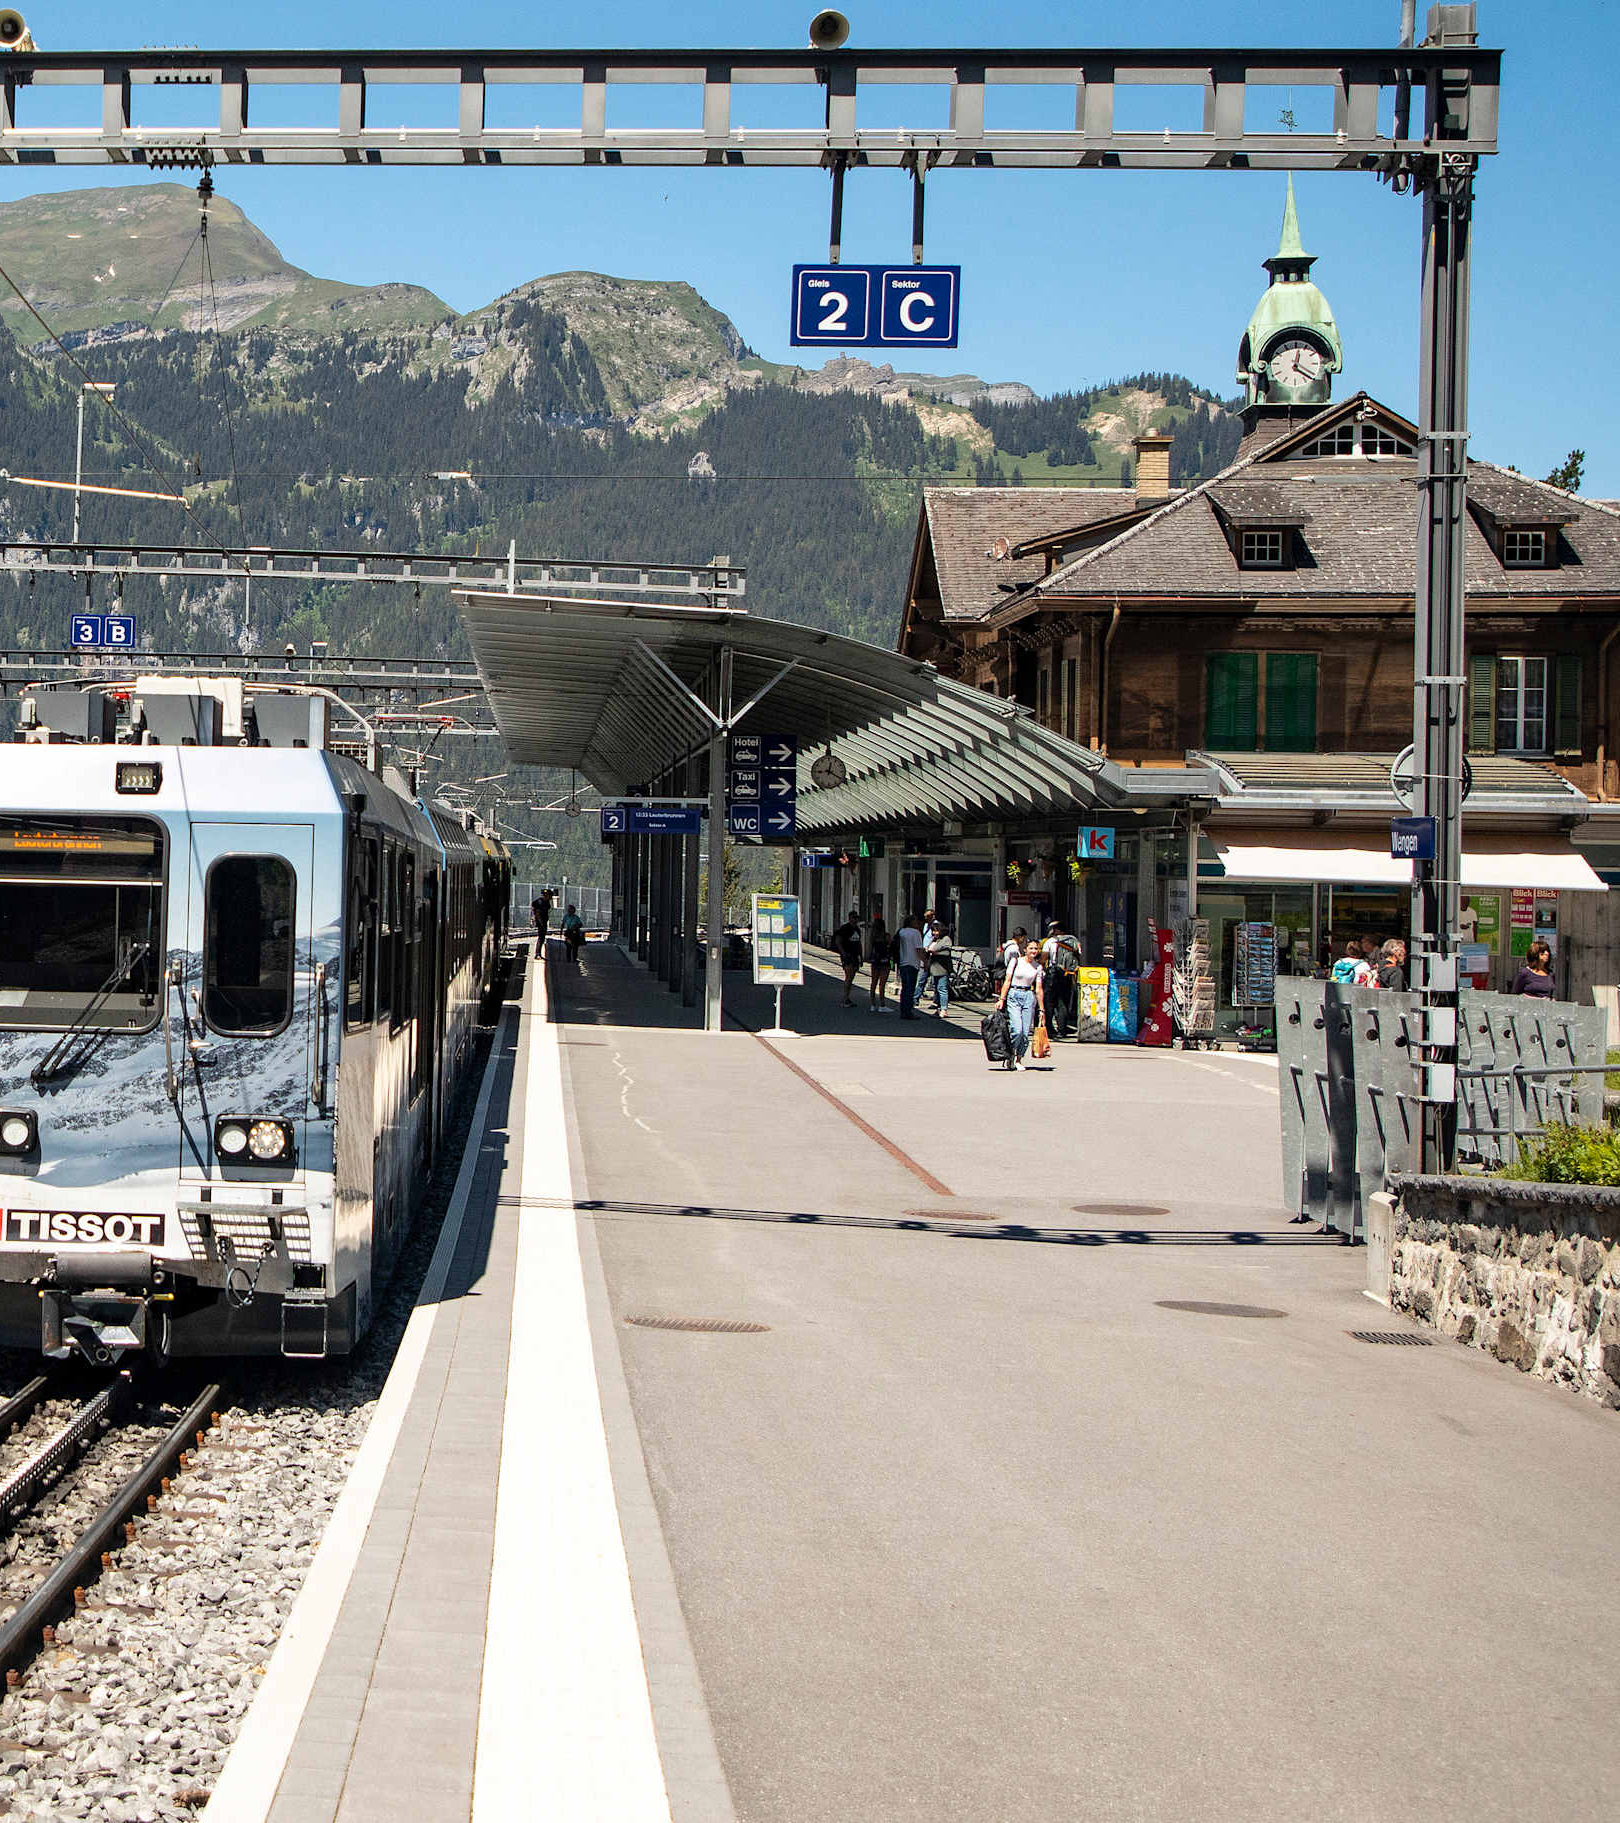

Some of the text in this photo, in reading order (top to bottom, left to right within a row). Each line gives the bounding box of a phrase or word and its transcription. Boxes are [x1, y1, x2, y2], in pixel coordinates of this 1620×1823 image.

[807, 279, 830, 288] Gleis
[891, 280, 921, 289] Sektor
[818, 291, 849, 331] 2
[899, 291, 935, 332] C
[80, 625, 93, 642] 3
[112, 626, 126, 642] B
[734, 738, 759, 746] Hotel
[736, 772, 756, 781] Taxi
[608, 816, 619, 829] 2
[733, 818, 757, 830] WC
[1089, 830, 1109, 850] k
[1391, 831, 1418, 856] Wengen
[1513, 889, 1533, 897] Blick
[1537, 889, 1557, 898] Blick
[10, 1211, 162, 1243] TISSOT
